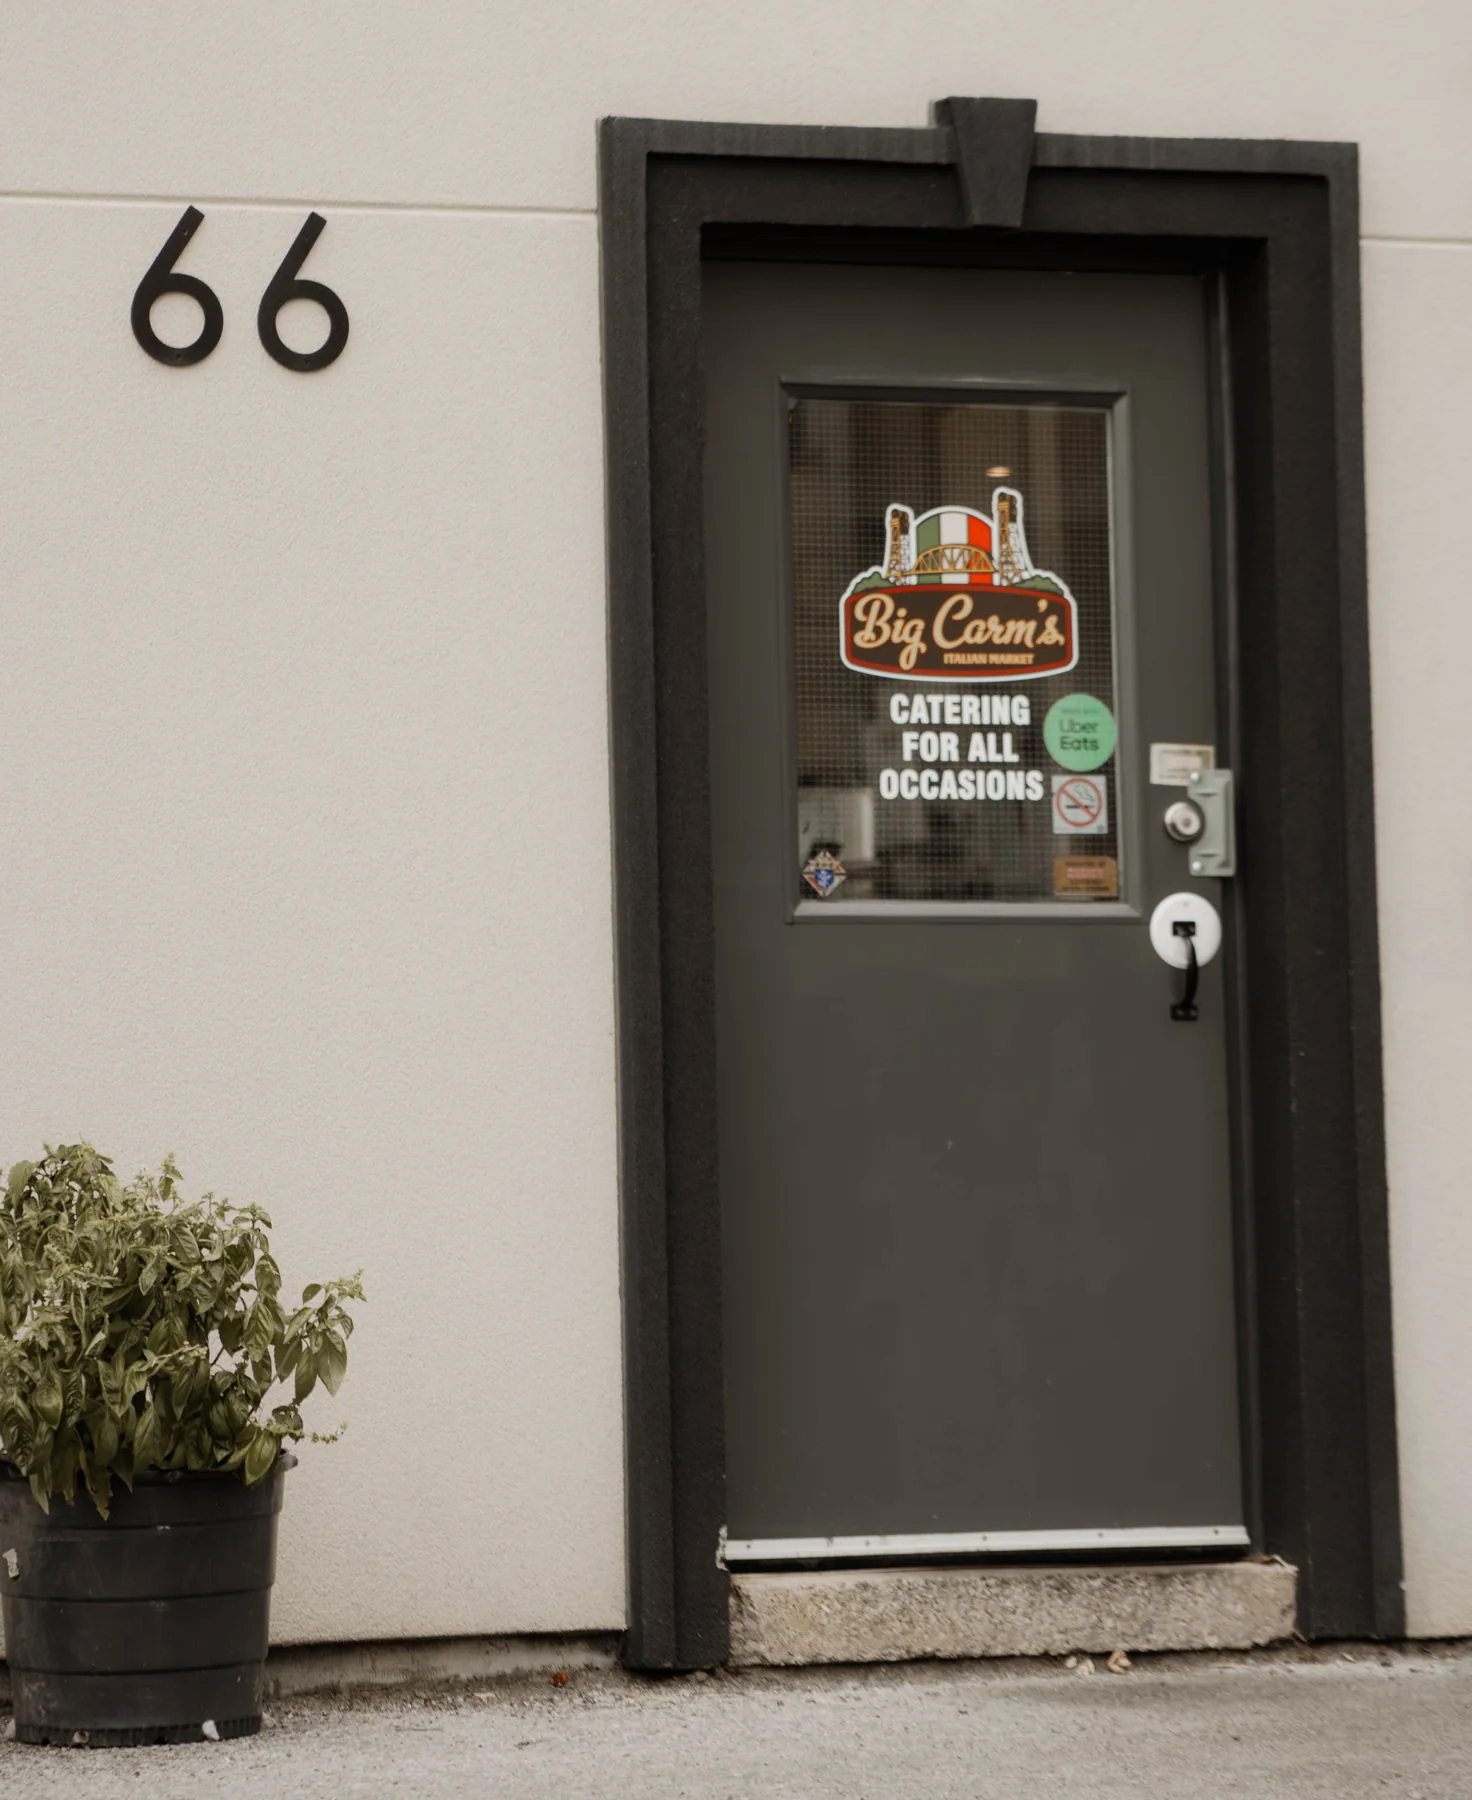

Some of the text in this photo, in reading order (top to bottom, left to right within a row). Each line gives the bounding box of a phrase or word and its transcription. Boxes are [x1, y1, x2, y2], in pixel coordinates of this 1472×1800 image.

[131, 205, 349, 373] 66
[853, 593, 1065, 670] Big Carm's
[943, 653, 1034, 665] ITALIAN MARKET
[889, 693, 1031, 726] CATERING
[1059, 718, 1099, 734] Uber
[902, 731, 1020, 763] FOR ALL
[1059, 735, 1100, 751] Eats
[879, 769, 1045, 802] OCCASIONS
